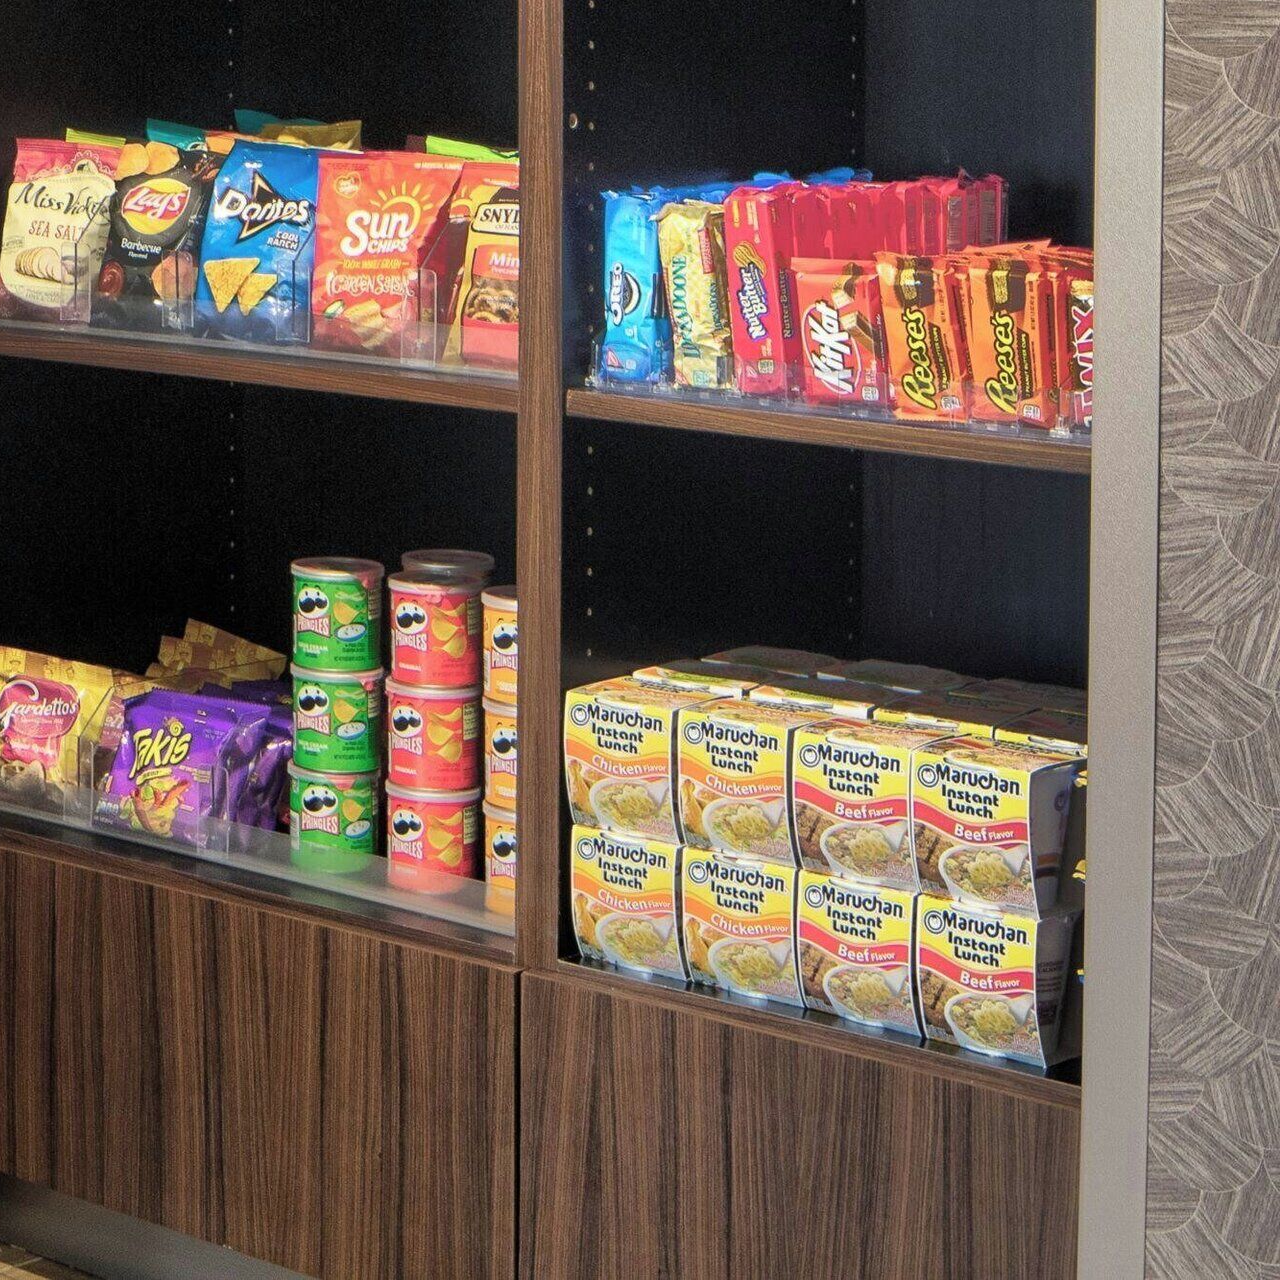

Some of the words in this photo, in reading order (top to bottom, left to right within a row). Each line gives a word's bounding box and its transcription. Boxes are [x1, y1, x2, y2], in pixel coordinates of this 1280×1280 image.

[14, 183, 63, 211] Miss
[123, 186, 187, 220] Lay's
[213, 188, 310, 224] Doritos
[480, 207, 519, 223] SNY
[28, 220, 50, 238] SEA
[54, 224, 85, 241] SALT
[340, 209, 413, 257] Sun
[121, 237, 162, 254] Barbecue
[367, 238, 410, 255] CHIPS
[489, 251, 519, 267] Min
[610, 263, 623, 326] OREO
[672, 256, 688, 312] DOONE
[740, 267, 768, 316] Butter
[738, 291, 768, 340] Nutter
[902, 307, 938, 410] Reese's
[985, 311, 1019, 415] Reese's
[395, 631, 428, 651] PRINGLES
[492, 652, 517, 671] PRINGL
[586, 703, 663, 732] Maruchan
[591, 722, 644, 743] Instant
[700, 721, 778, 751] Maruchan
[391, 734, 423, 755] PRINGLES
[597, 736, 638, 754] Lunch
[705, 741, 759, 762] Instant
[491, 755, 517, 775] PRINGL
[592, 754, 643, 775] Chicken
[643, 763, 666, 773] Flavor
[711, 755, 753, 773] Lunch
[817, 745, 900, 773] Maruchan
[705, 775, 757, 794] Chicken
[757, 783, 782, 792] Flavor
[822, 764, 880, 784] Instant
[935, 763, 1020, 796] Maruchan
[828, 779, 874, 797] Lunch
[941, 787, 999, 807] Instant
[834, 801, 869, 818] Beef
[869, 806, 894, 817] Flavor
[947, 800, 993, 820] Lunch
[302, 813, 339, 835] PRINGLES
[954, 824, 987, 842] Beef
[988, 829, 1014, 840] Flavor
[392, 839, 423, 860] PRINGLES
[593, 837, 667, 868] Maruchan
[491, 859, 516, 877] PRINGL
[597, 857, 648, 879] Instant
[705, 861, 785, 892] Maruchan
[603, 870, 643, 890] Lunch
[597, 888, 648, 911] Chicken
[648, 899, 671, 909] Flavor
[710, 881, 765, 902] Instant
[822, 885, 903, 918] Maruchan
[716, 895, 759, 914] Lunch
[710, 913, 764, 935] Chicken
[764, 924, 788, 933] Flavor
[826, 906, 883, 929] Instant
[942, 910, 1027, 944] Maruchan
[832, 920, 877, 941] Lunch
[838, 944, 870, 962] Beef
[870, 951, 896, 961] Flavor
[947, 931, 1006, 956] Instant
[954, 946, 1000, 967] Lunch
[960, 971, 993, 989] Beef
[994, 978, 1020, 988] Flavor
